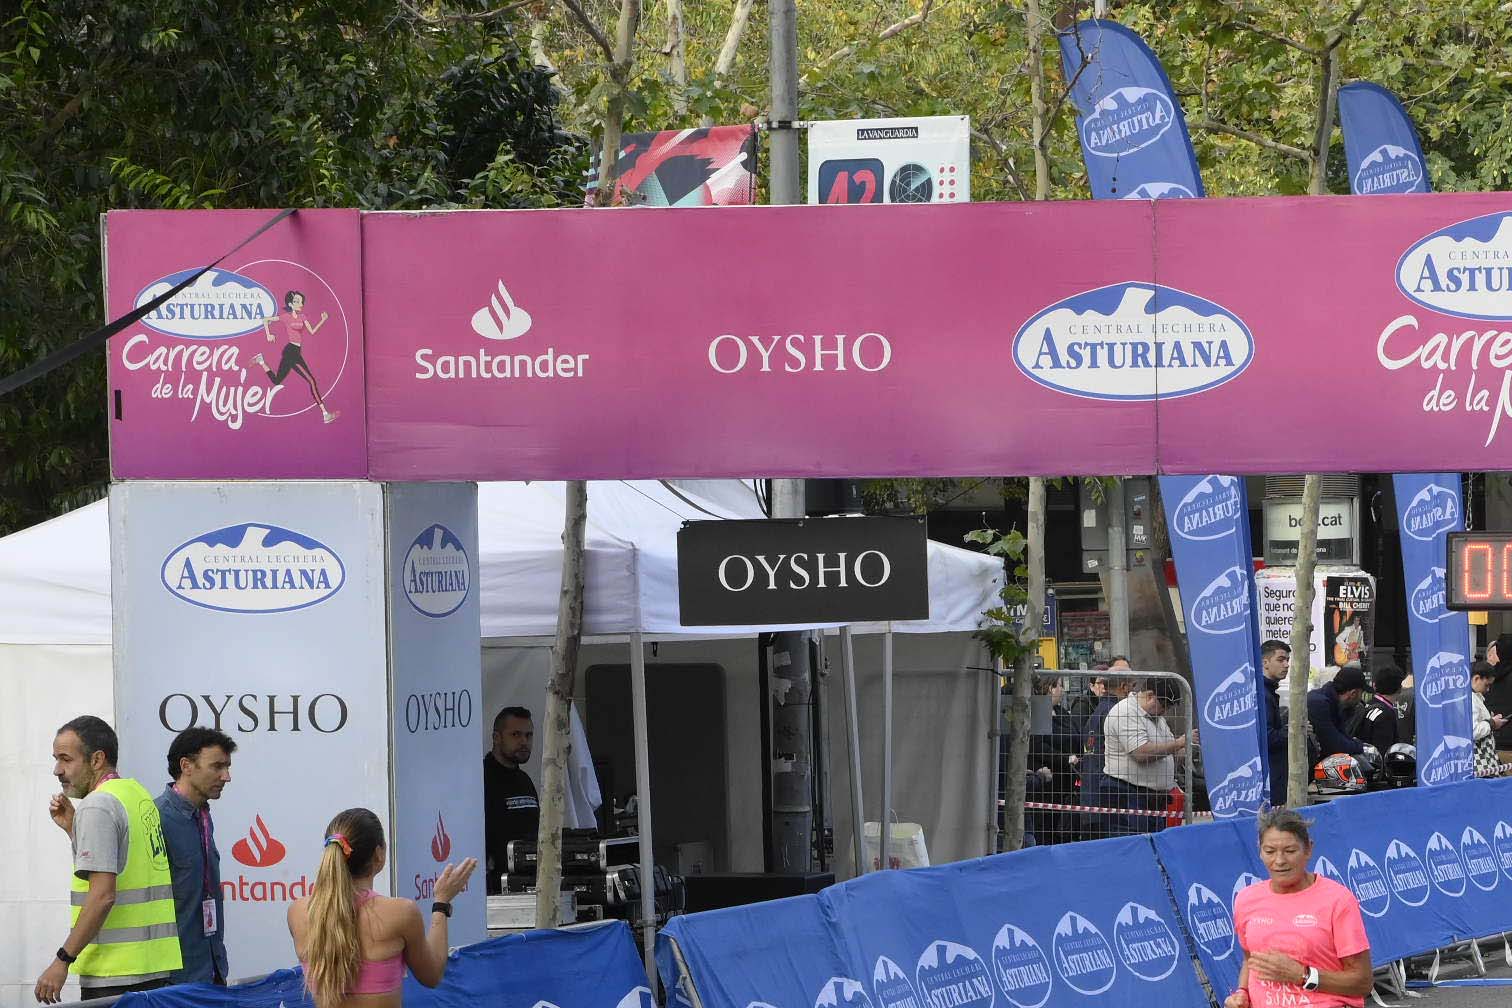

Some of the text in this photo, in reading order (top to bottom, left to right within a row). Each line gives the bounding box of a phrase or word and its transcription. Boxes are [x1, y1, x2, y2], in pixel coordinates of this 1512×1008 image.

[867, 127, 918, 138] VANGUARDIA
[826, 169, 877, 204] 42
[174, 291, 262, 299] ENTRAL LECHERA
[1069, 321, 1228, 335] CENTRAL LECHERA
[122, 333, 240, 372] Carrera
[415, 346, 591, 380] Santander
[707, 332, 893, 374] OYSHO
[1032, 326, 1236, 371] ASTURIANA
[151, 367, 285, 430] de la Mujer
[1422, 372, 1458, 413] de
[1465, 371, 1490, 412] la
[176, 556, 332, 591] ASTURIANA
[203, 554, 327, 564] CENTRAL LECHERA
[408, 557, 467, 595] ASTURIANA
[718, 550, 892, 592] OYSHO
[1339, 585, 1370, 598] ELVIS
[1264, 603, 1281, 616] que
[159, 693, 349, 734] OYSHO
[405, 688, 473, 735] OYSHO
[220, 875, 315, 902] ntand
